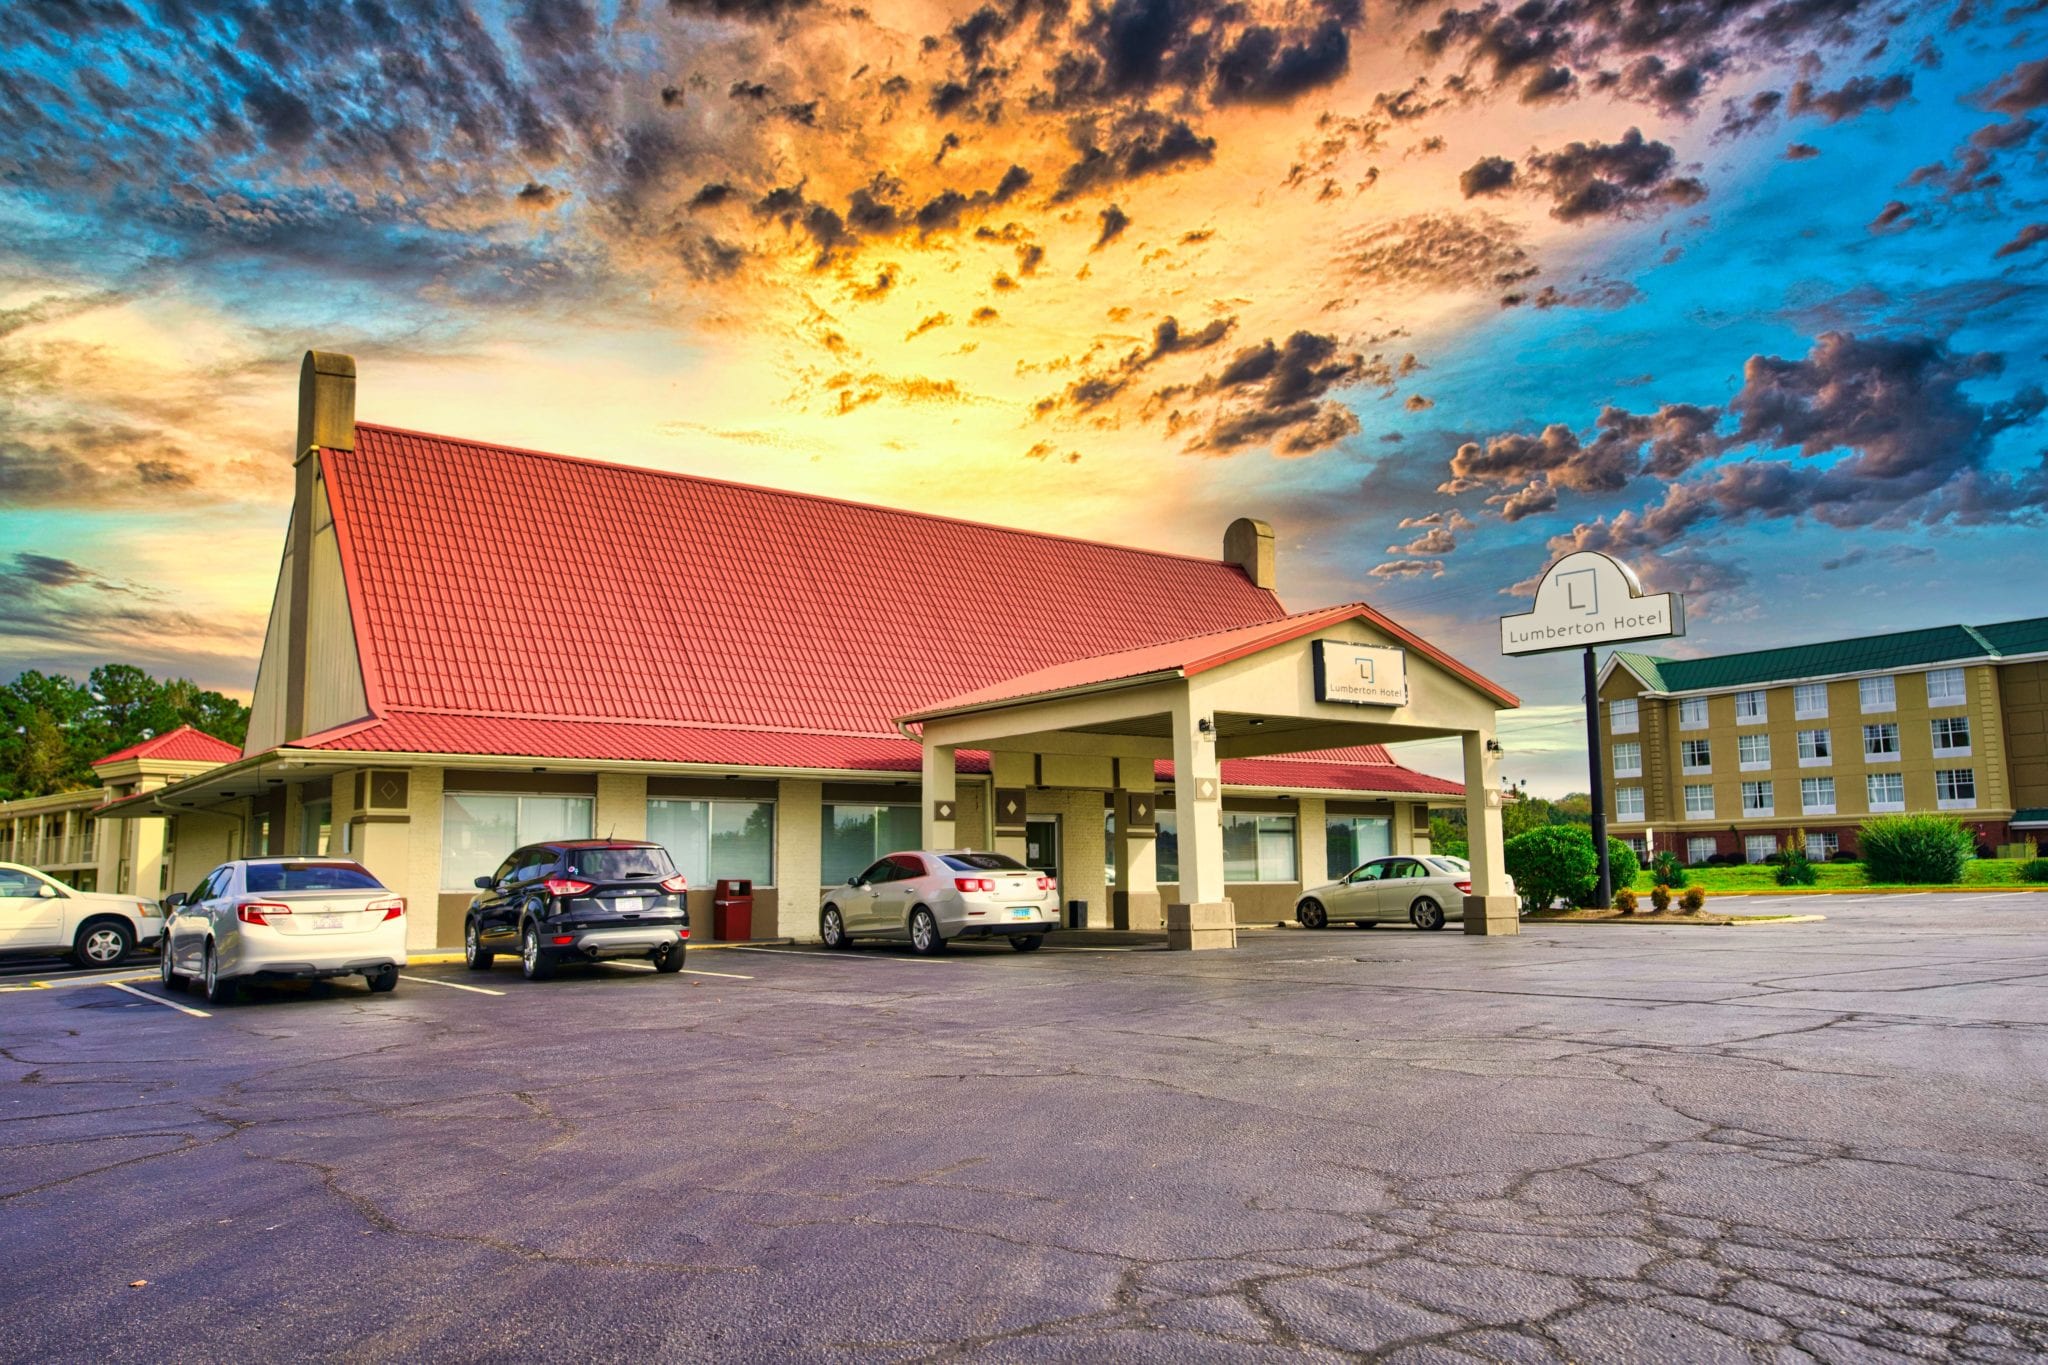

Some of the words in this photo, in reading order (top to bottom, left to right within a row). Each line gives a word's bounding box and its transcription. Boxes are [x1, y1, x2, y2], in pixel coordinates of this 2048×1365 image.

[1568, 583, 1586, 609] L
[1510, 622, 1605, 643] Lumberton
[1614, 610, 1663, 630] Hotel
[1361, 664, 1369, 679] L
[1331, 684, 1377, 695] Lumberton
[1380, 688, 1402, 697] Hotel
